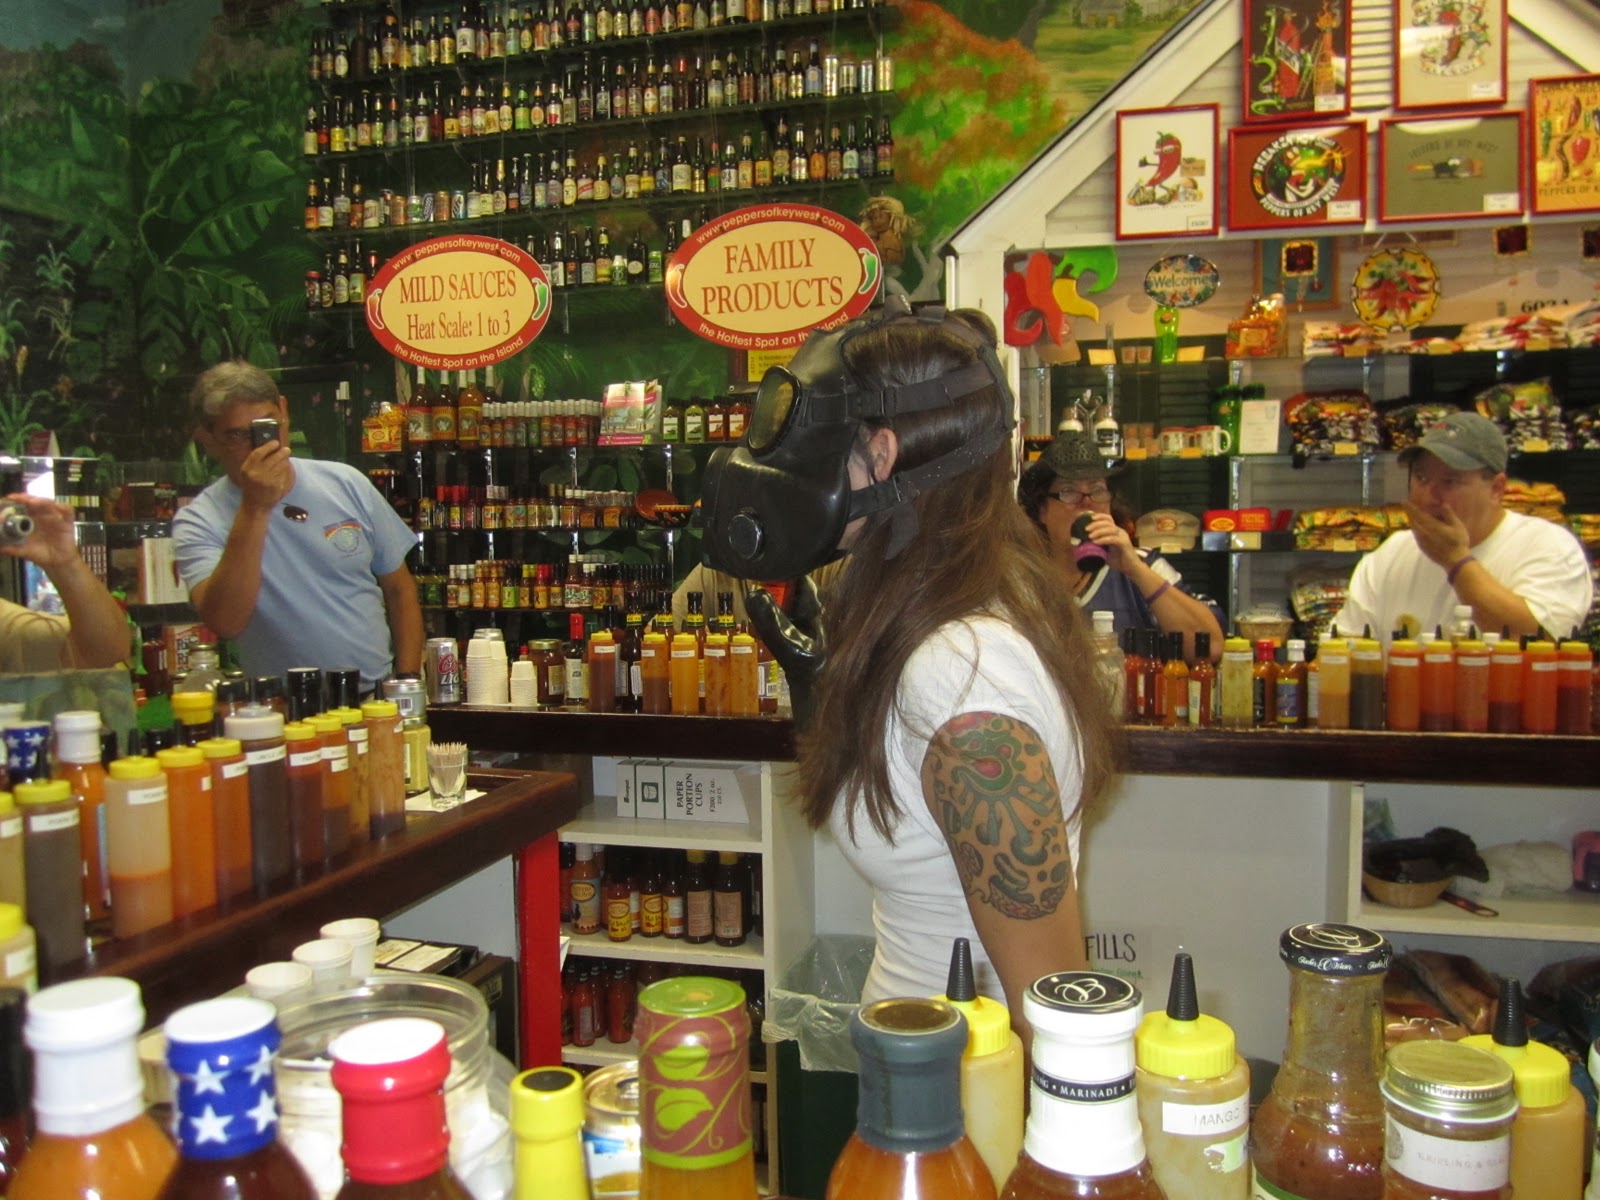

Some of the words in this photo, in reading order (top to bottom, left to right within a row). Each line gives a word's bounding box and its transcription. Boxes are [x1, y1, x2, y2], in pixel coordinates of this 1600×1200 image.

[724, 238, 816, 275] FAMILY
[399, 274, 444, 304] MILD
[448, 269, 517, 301] SAUCES
[701, 276, 843, 315] PRODUCTS
[1153, 274, 1208, 288] Welcome
[407, 313, 435, 341] Heat
[438, 311, 473, 339] Scale:
[477, 312, 484, 337] 1
[488, 315, 500, 336] to
[502, 309, 511, 335] 3
[699, 322, 715, 337] the
[716, 332, 752, 346] Hottest
[755, 335, 779, 348] Spot
[782, 335, 796, 344] on
[818, 312, 849, 331] sland
[394, 343, 408, 357] the
[409, 351, 441, 367] Hottest
[442, 358, 464, 369] Spot
[466, 358, 477, 366] on
[479, 352, 495, 362] the
[496, 337, 524, 357] Island
[676, 781, 684, 808] PAPER
[685, 773, 694, 816] PORTION
[695, 782, 703, 807] CUPS
[1084, 933, 1136, 962] FILLS
[1060, 1085, 1118, 1098] MARINADE
[1194, 1107, 1240, 1126] MANGO
